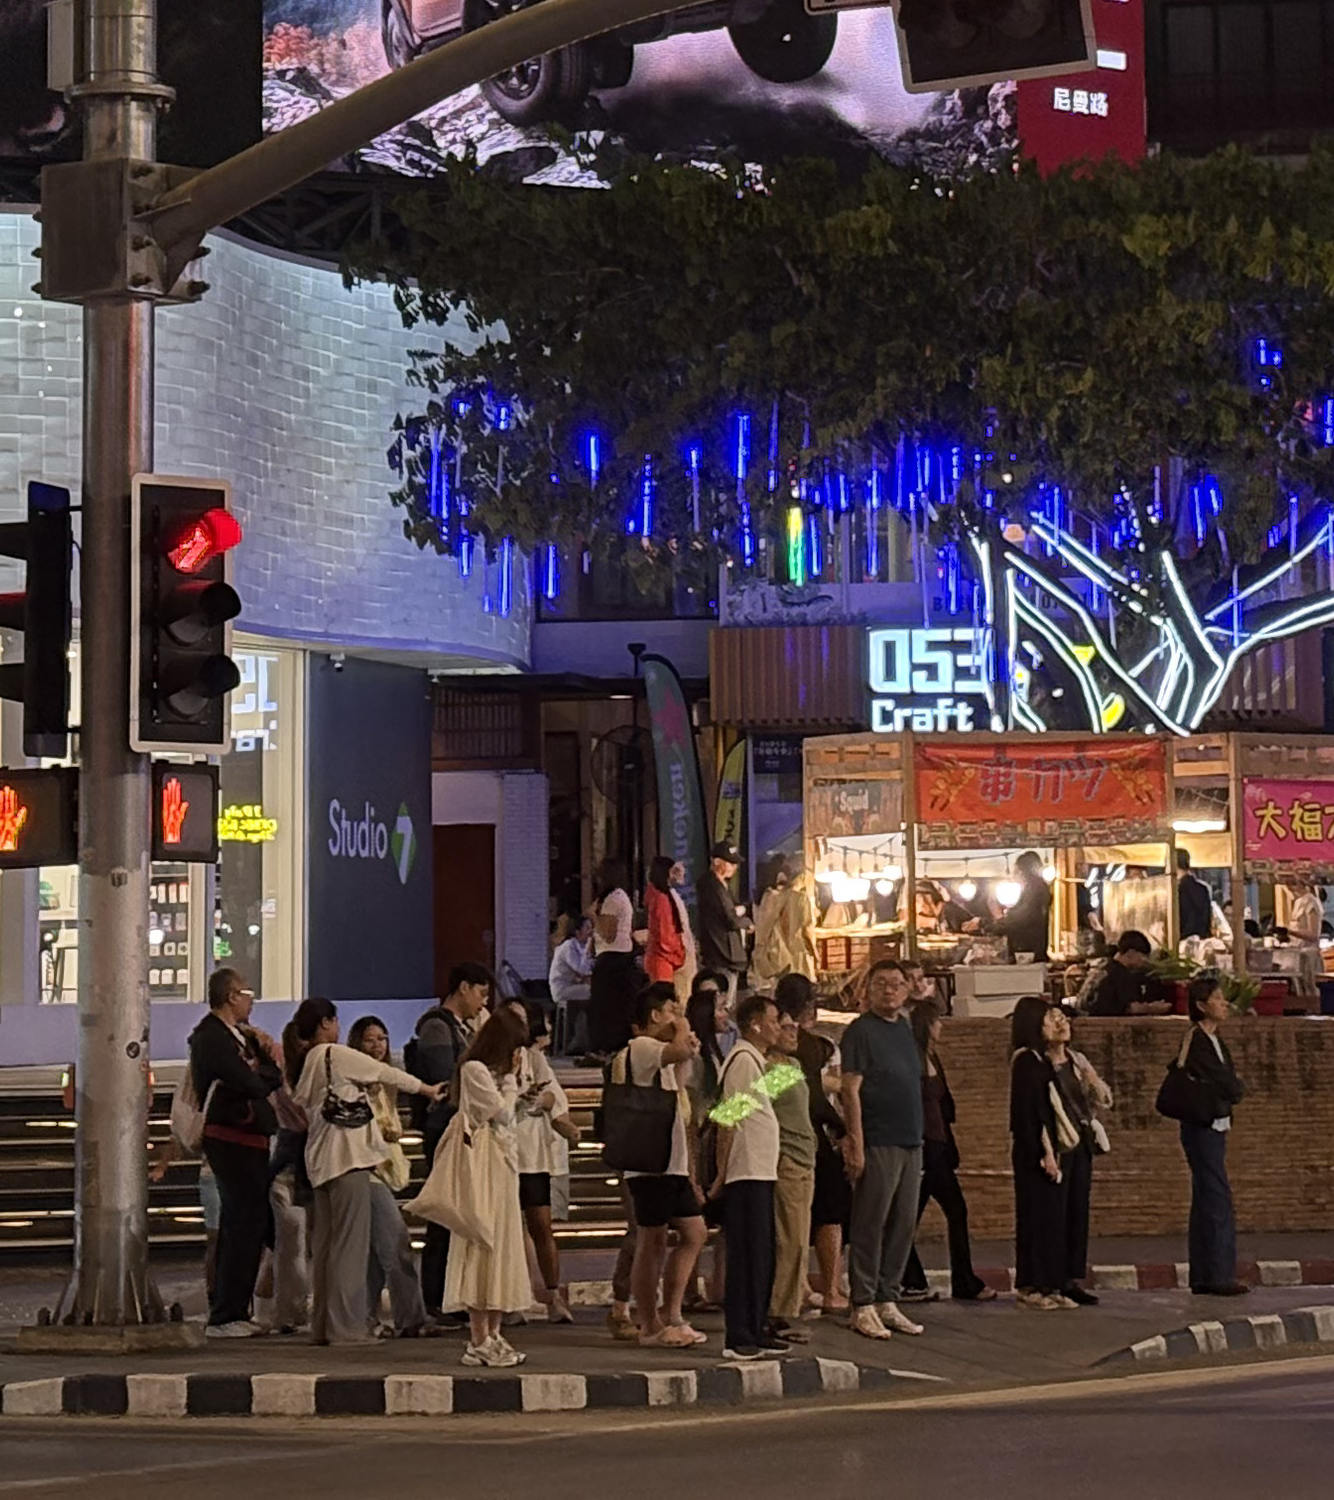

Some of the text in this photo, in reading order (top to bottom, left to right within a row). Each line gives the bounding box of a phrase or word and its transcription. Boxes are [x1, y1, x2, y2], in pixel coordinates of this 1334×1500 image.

[869, 629, 991, 693] 053
[871, 698, 974, 733] Craft
[328, 798, 388, 859] Studio
[396, 815, 414, 885] 7
